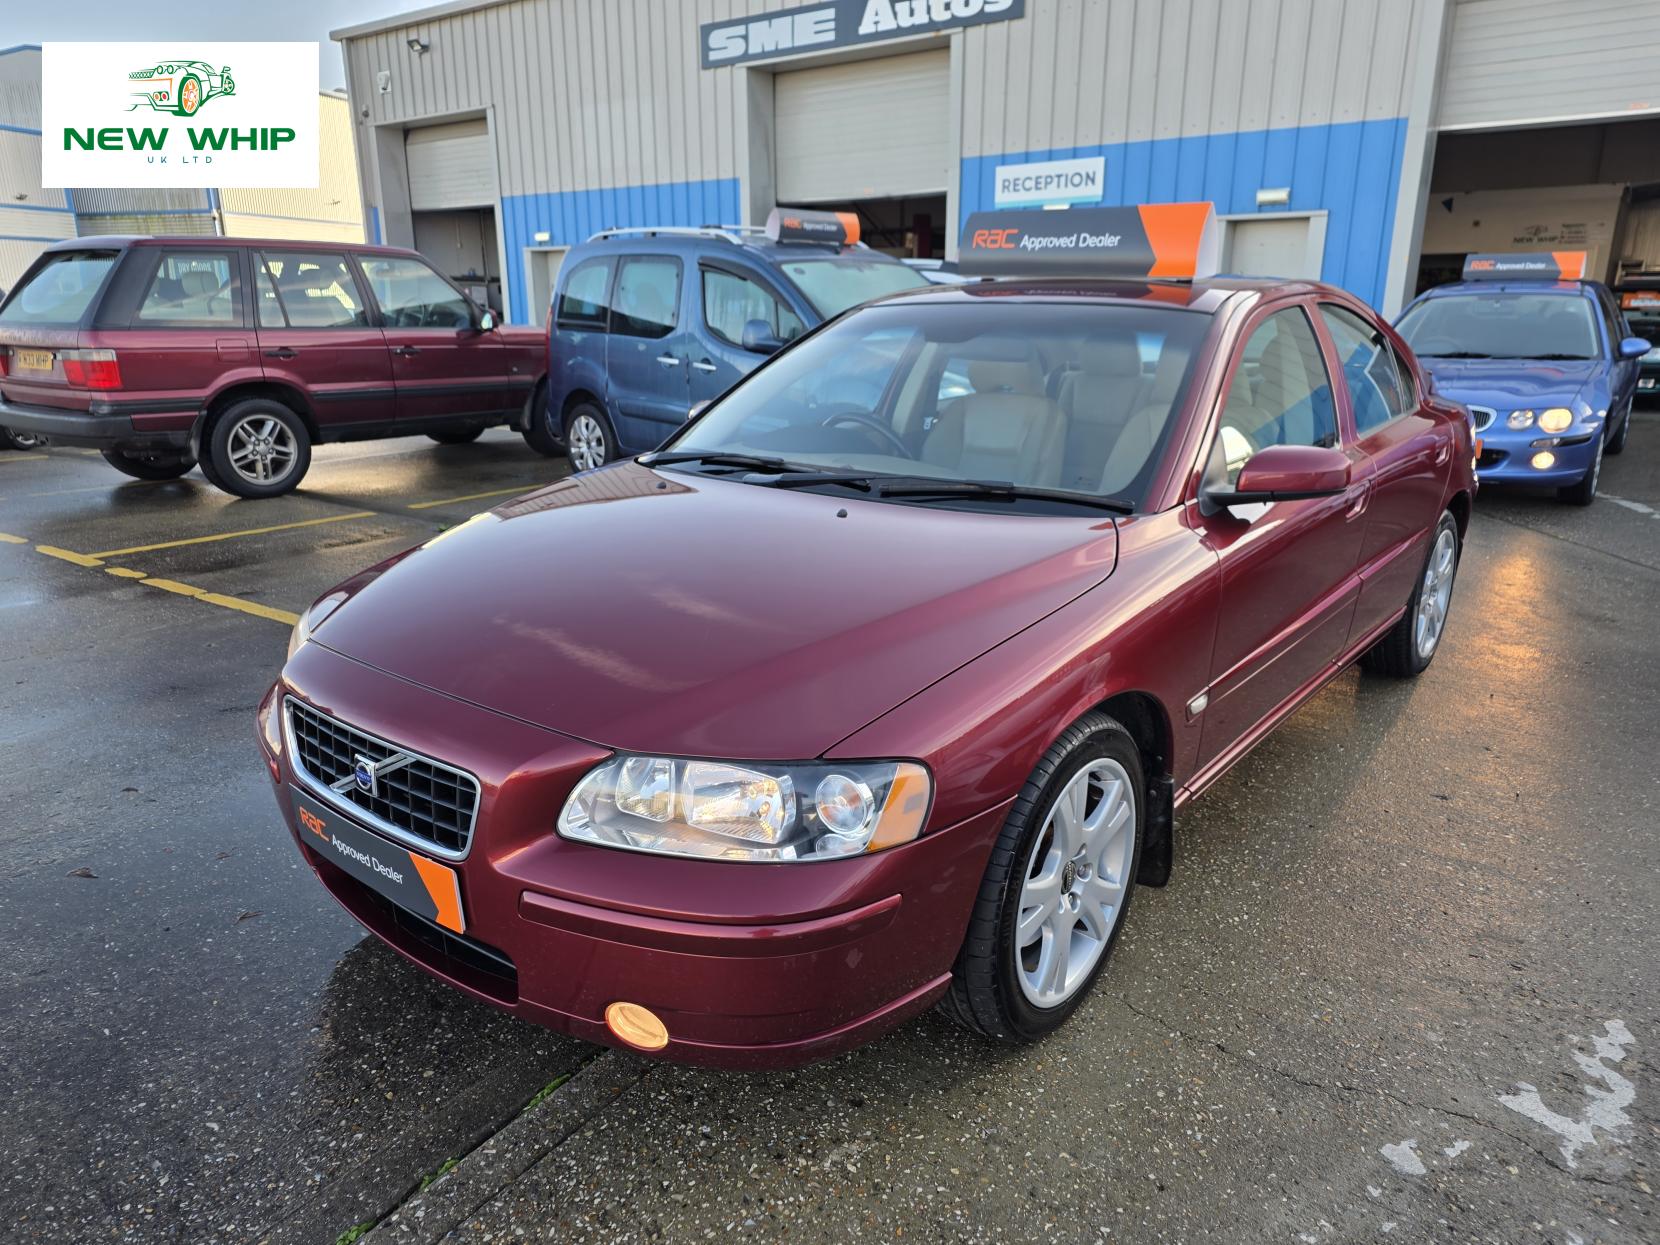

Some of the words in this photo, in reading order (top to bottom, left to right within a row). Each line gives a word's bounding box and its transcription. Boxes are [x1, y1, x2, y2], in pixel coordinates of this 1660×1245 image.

[708, 8, 836, 61] SME
[1001, 171, 1097, 194] RECEPTION
[1020, 234, 1077, 251] Approved
[1079, 232, 1121, 248] Dealer
[332, 834, 371, 867] Approved
[371, 857, 403, 884] Dealer
